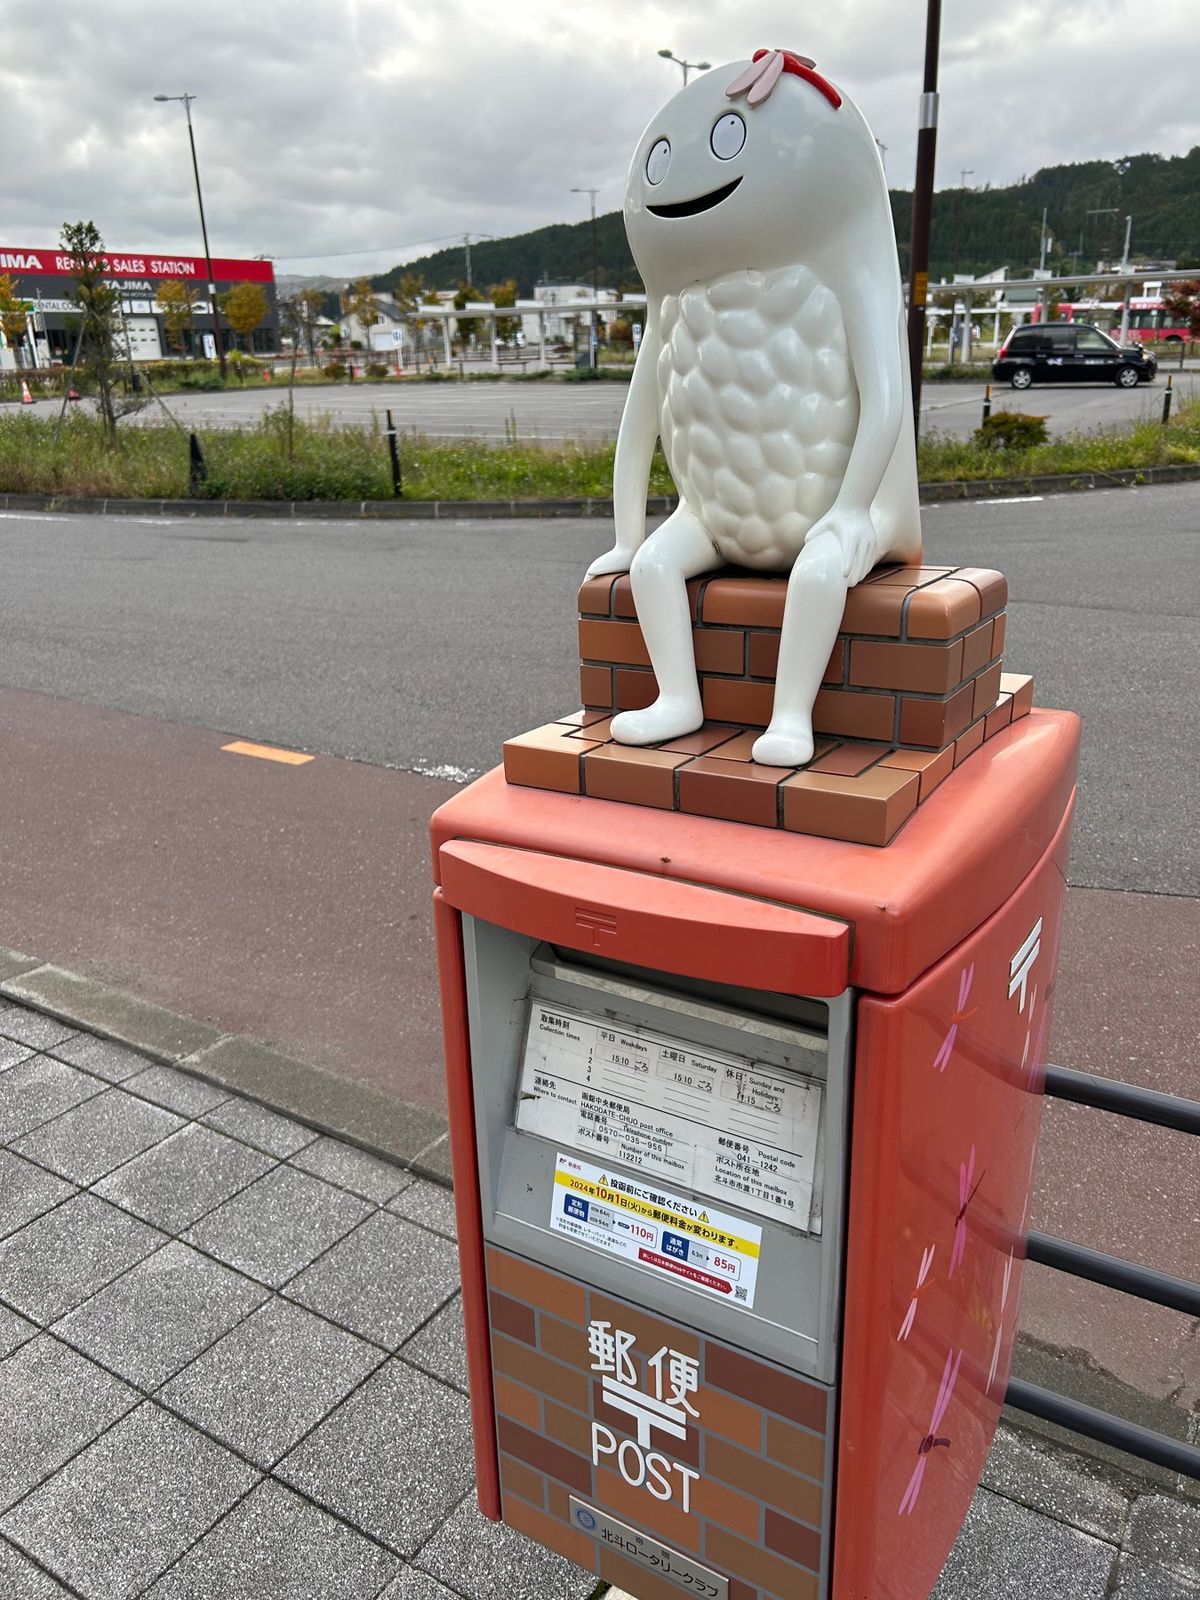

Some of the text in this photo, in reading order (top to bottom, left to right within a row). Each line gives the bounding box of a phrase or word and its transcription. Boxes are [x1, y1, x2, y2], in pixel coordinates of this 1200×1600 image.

[113, 260, 146, 273] SALES
[151, 261, 196, 275] STATION
[103, 280, 152, 291] TAJIMA
[540, 1013, 570, 1030] 取集時刻
[540, 1024, 581, 1041] Collection times
[601, 1031, 648, 1052] 平日 Weekdays
[634, 1060, 649, 1073] ごろ
[661, 1049, 718, 1074] 土曜日 Saturday
[534, 1076, 557, 1090] 連絡先
[697, 1080, 713, 1092] ごろ
[726, 1068, 786, 1094] 休日 Sunday and
[533, 1086, 549, 1097] Where
[557, 1094, 577, 1106] contact
[581, 1091, 631, 1114] 函館中央郵便局
[752, 1088, 779, 1101] Holidays
[764, 1101, 781, 1113] ごろ
[580, 1101, 674, 1138] HAKODATE-CHUO post office
[580, 1109, 608, 1126] 電話番号
[652, 1135, 674, 1147] number
[578, 1127, 685, 1170] ポスト番号 Number of this mailbox
[618, 1150, 643, 1165] 112212
[718, 1137, 795, 1168] 郵便番号 Postal code
[716, 1156, 760, 1177] ポスト所在地
[715, 1165, 741, 1179] Location
[750, 1178, 762, 1187] this
[764, 1183, 788, 1196] mailbox
[610, 1178, 697, 1217] 投函前にご確認ください
[630, 1224, 654, 1242] 110円
[666, 1244, 684, 1256] はがき
[714, 1256, 736, 1275] 85円
[588, 1320, 700, 1418] 郵便
[591, 1421, 700, 1513] POST
[601, 1528, 719, 1598] 北斗ロータリークラブ
